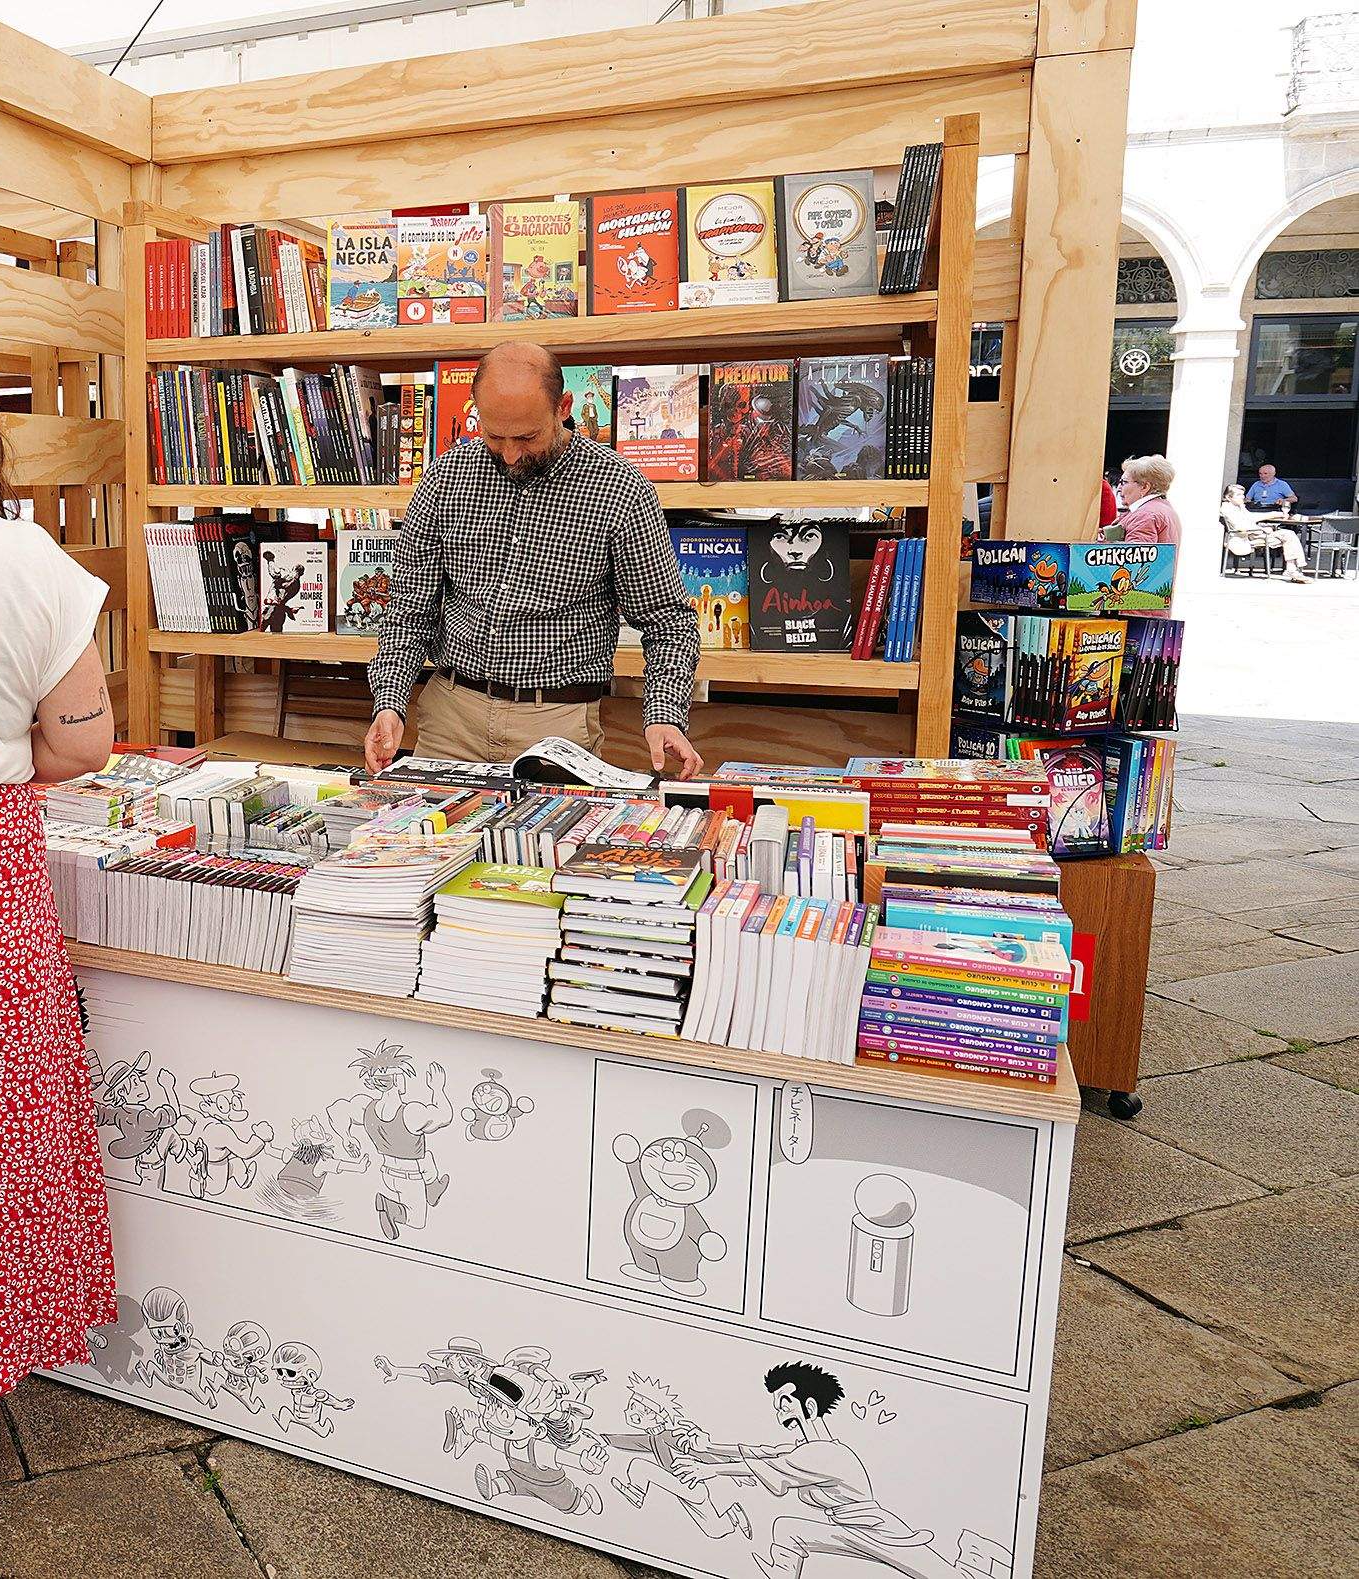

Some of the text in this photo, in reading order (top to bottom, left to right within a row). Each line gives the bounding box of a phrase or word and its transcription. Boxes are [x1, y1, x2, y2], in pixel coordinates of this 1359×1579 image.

[505, 213, 572, 224] EL BOTONES
[597, 208, 672, 234] MORTADELO
[503, 222, 572, 237] SACARINO
[616, 220, 673, 240] FILEMÓN
[814, 221, 821, 229] Y
[400, 226, 484, 246] el combate de los jefes
[336, 236, 393, 251] LA ISLA
[336, 250, 389, 266] NEGRA
[442, 370, 477, 385] LUCK
[714, 364, 790, 385] PREDATOR
[807, 363, 880, 381] ALIENS
[402, 389, 413, 409] AKIRA
[414, 389, 424, 409] AKIRA
[652, 389, 679, 398] VIVOS
[351, 538, 397, 551] LA GUERR
[679, 543, 743, 555] EL INCAL
[349, 551, 361, 563] DE
[977, 544, 1027, 566] POLICÁN
[316, 573, 323, 582] EL
[302, 582, 323, 591] ÚLTIMO
[300, 591, 323, 601] HOMBRE
[761, 586, 843, 615] Ainhoa
[315, 601, 323, 609] EN
[313, 609, 323, 618] PIE
[784, 618, 817, 631] BLACK
[785, 632, 817, 644] BELTZA
[960, 634, 1001, 651] POLICÁN
[1082, 630, 1122, 645] POLICÁN 6
[985, 740, 995, 755] 10
[1053, 771, 1096, 787] ÚNICO
[972, 963, 1006, 972] CANGURO
[966, 973, 1001, 982] CANGURO
[964, 986, 1000, 996] CANGURO
[956, 998, 992, 1008] CANGURO
[956, 1012, 991, 1023] CANGURO
[949, 1023, 984, 1033] CANGURO
[1011, 1020, 1029, 1028] CLUB
[959, 1037, 995, 1049] CANGURO
[1013, 1045, 1032, 1053] CLUB
[953, 1051, 989, 1061] CANGURO
[954, 1063, 990, 1073] CANGURO
[788, 1086, 804, 1158] チビネーター
